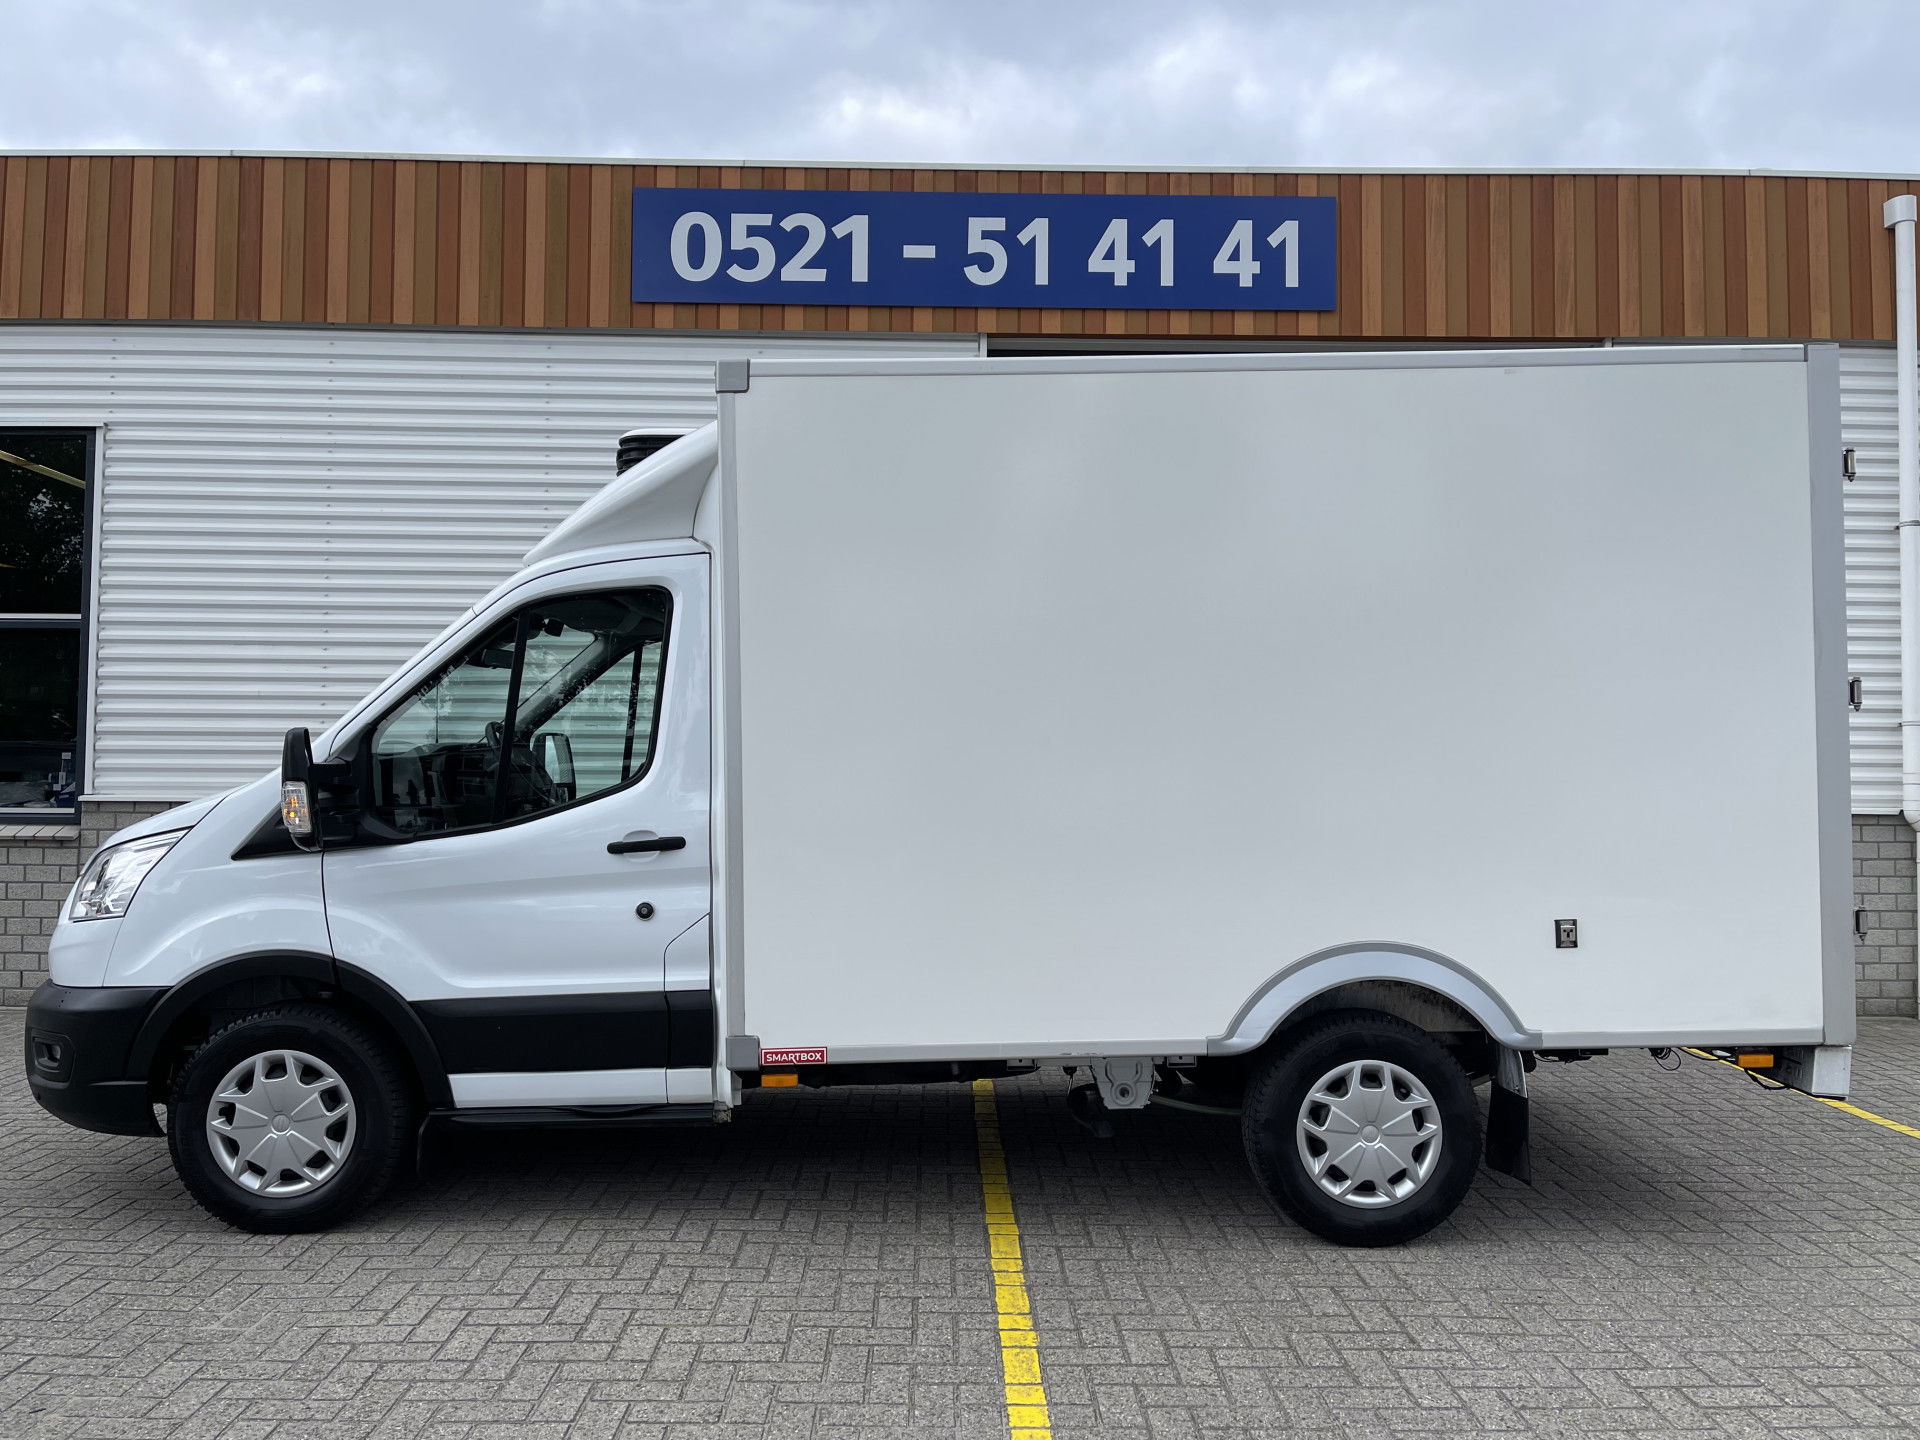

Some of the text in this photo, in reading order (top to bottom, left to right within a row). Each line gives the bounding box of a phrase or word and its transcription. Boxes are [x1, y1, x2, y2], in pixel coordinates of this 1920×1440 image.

[670, 211, 1299, 288] 0521 - 51 41 41
[766, 1052, 822, 1063] SMARTBOX
